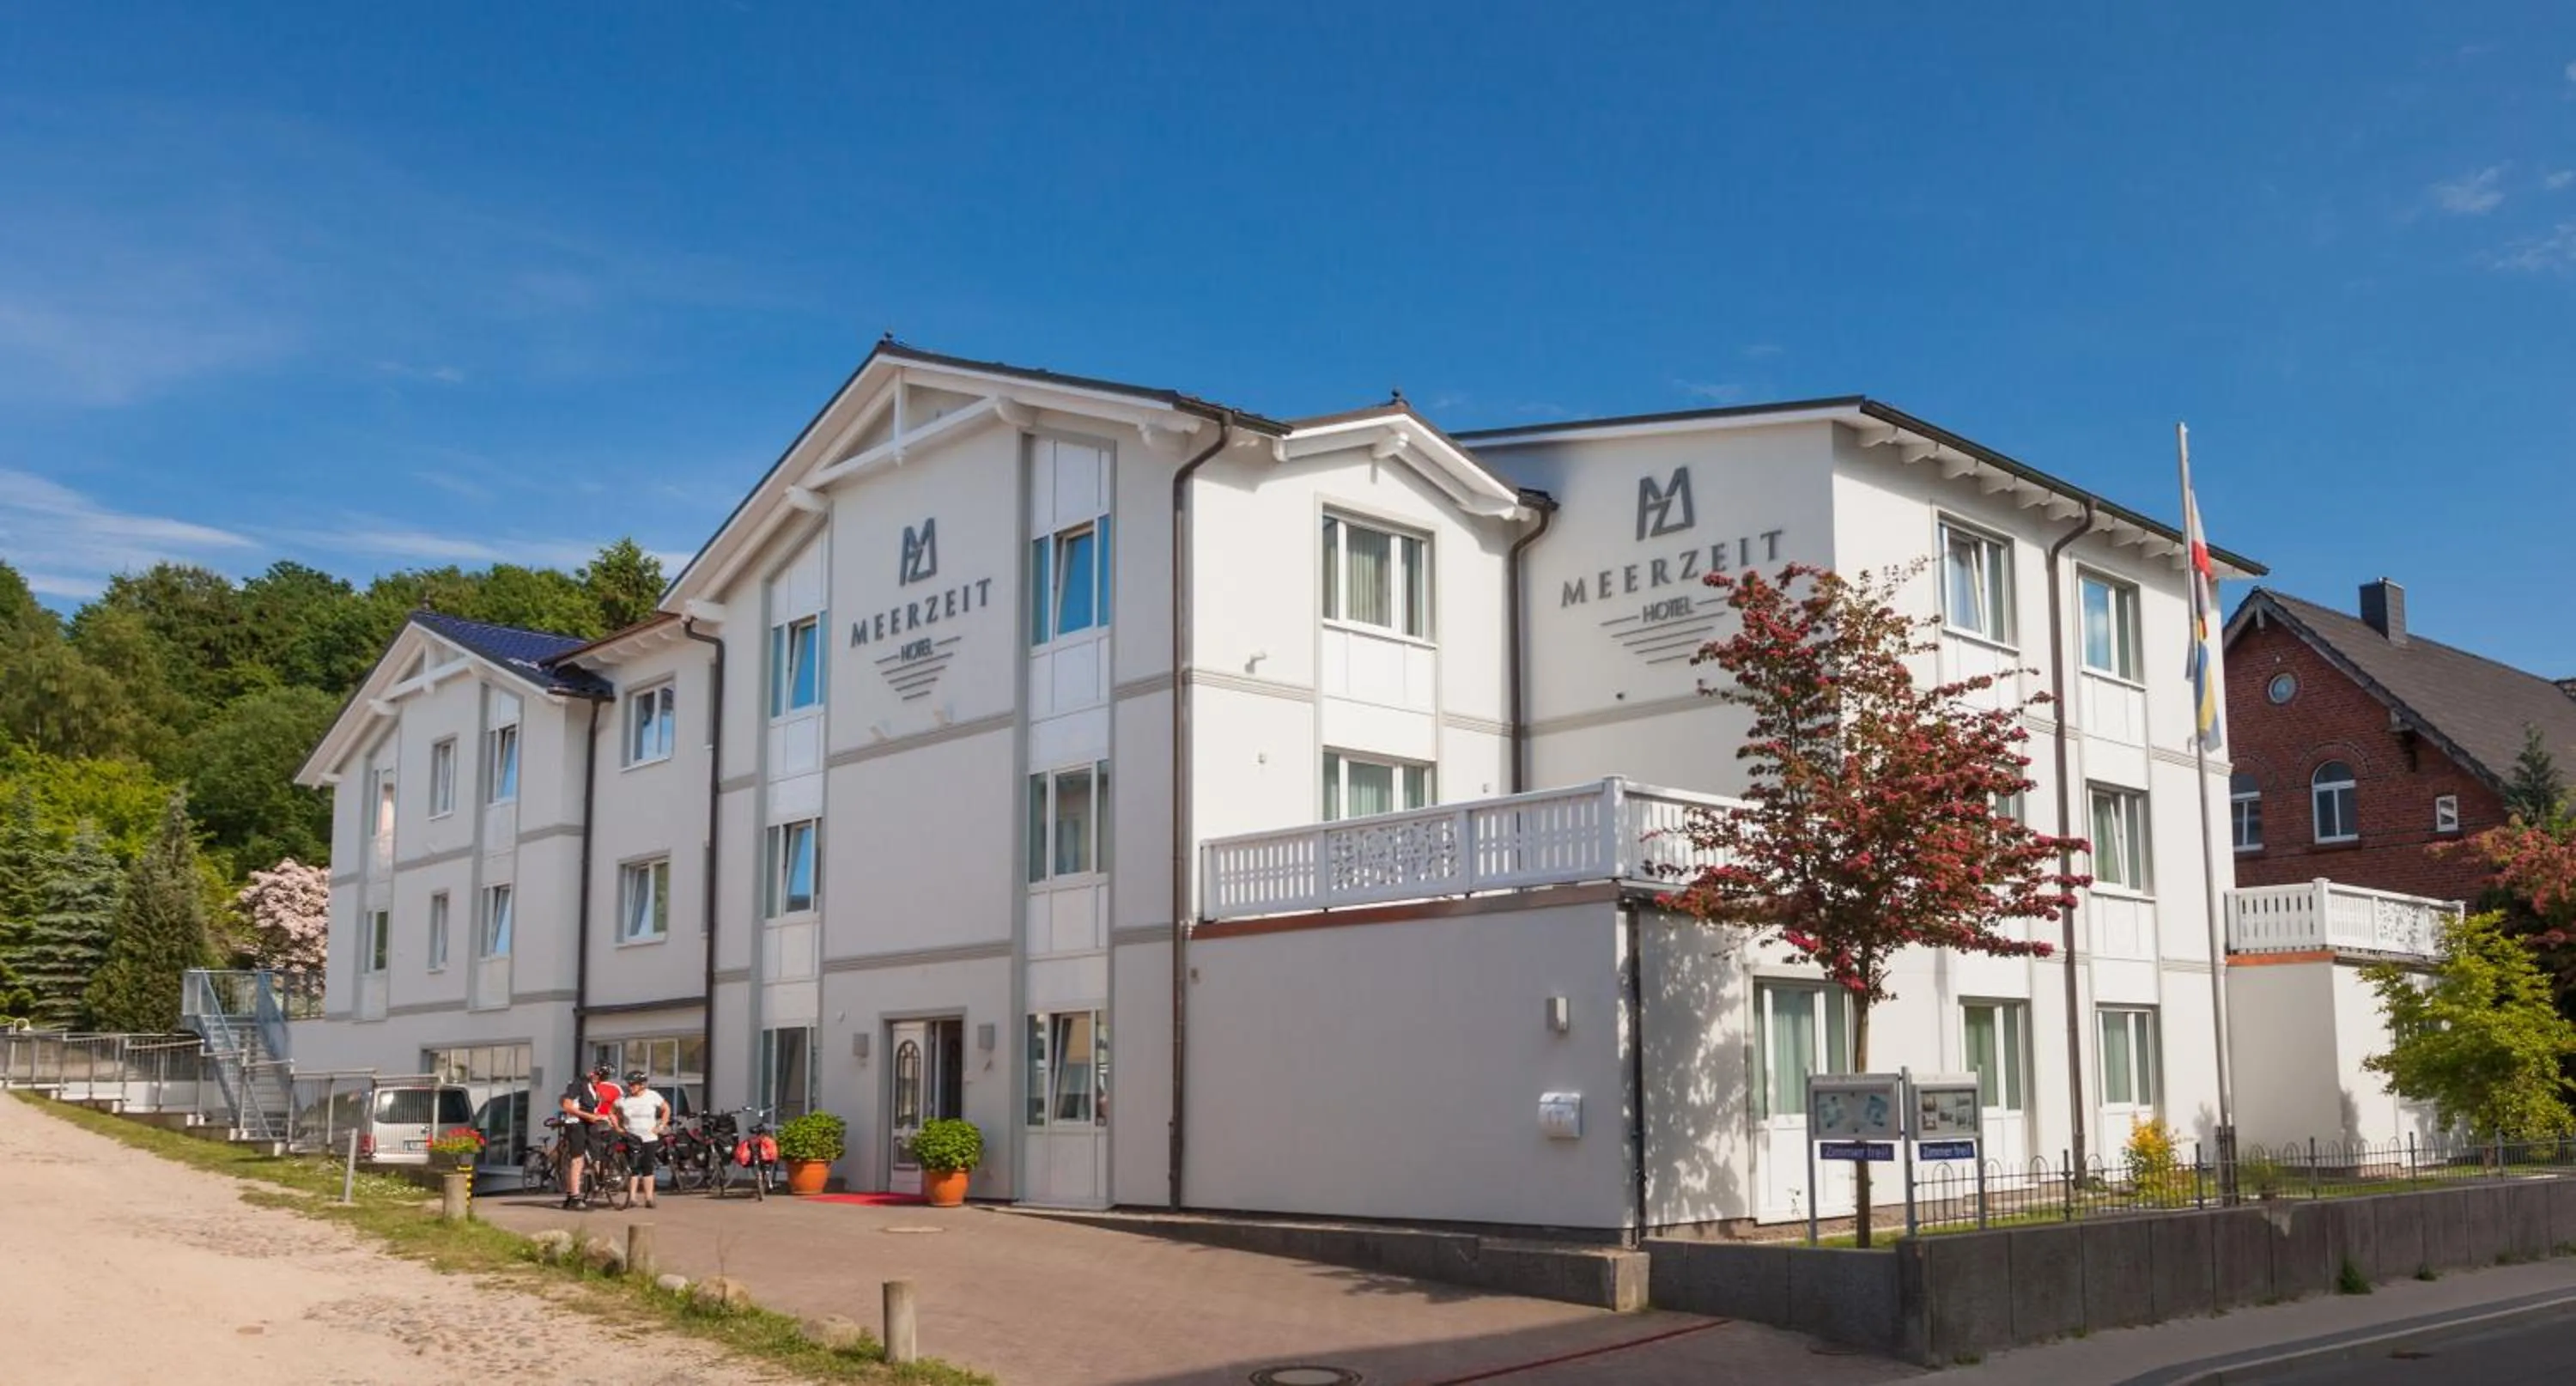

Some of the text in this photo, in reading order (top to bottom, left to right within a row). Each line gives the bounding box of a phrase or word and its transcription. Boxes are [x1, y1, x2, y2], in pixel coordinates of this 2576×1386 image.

[1561, 529, 1783, 608] MEERZEIT
[850, 577, 991, 648] MEERZEIT
[1643, 596, 1695, 623] HOTEL
[901, 637, 933, 661] HOTEL
